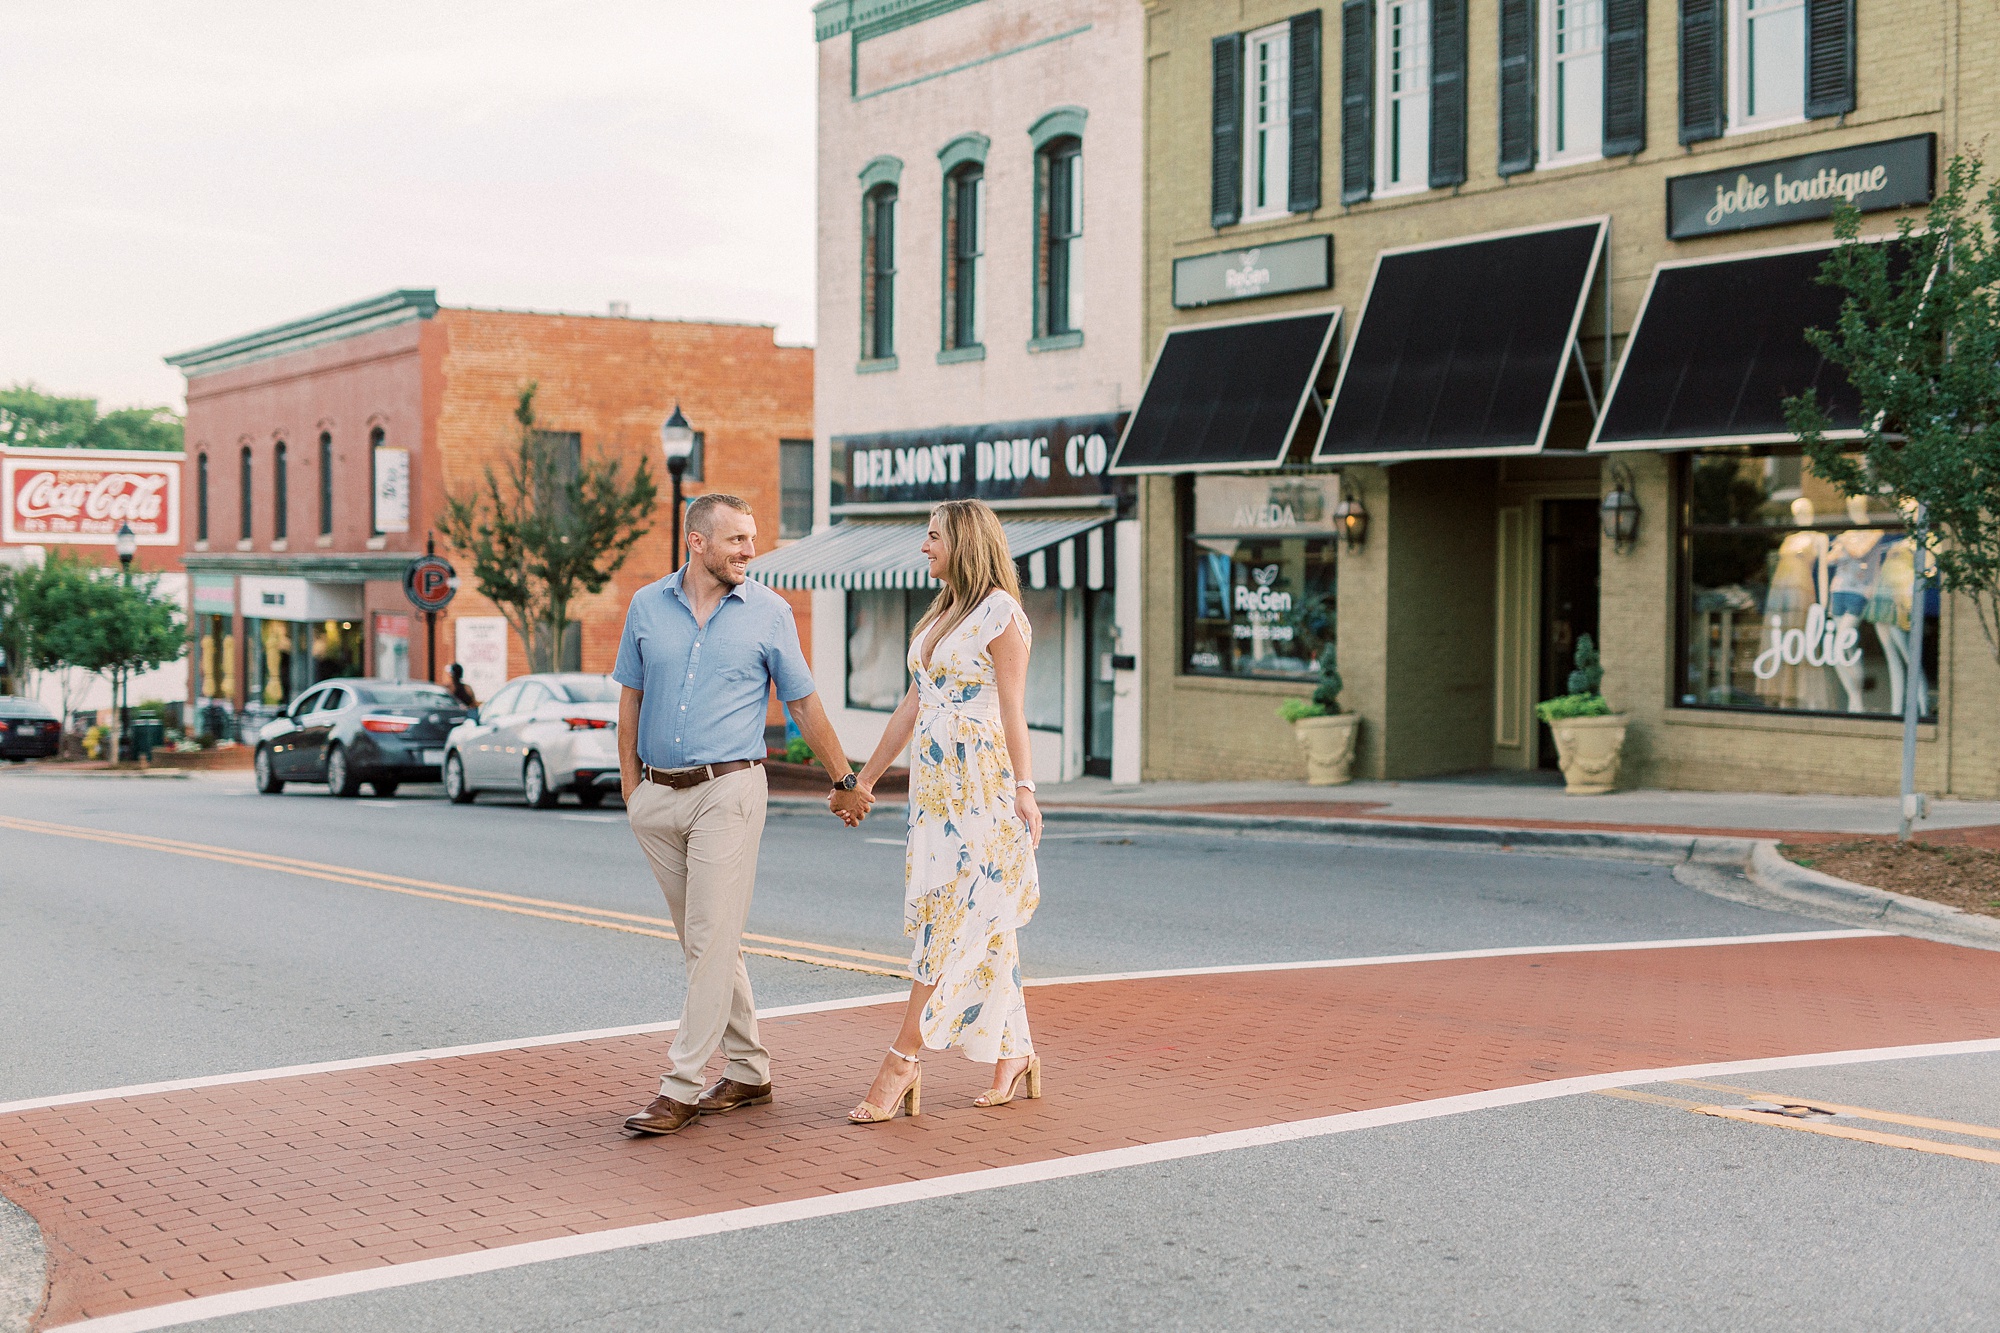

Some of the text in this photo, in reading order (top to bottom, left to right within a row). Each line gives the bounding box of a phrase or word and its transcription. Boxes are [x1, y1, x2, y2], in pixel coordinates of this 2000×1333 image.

[1706, 165, 1888, 226] jolie boutique
[1225, 266, 1270, 289] ReGen
[853, 433, 1107, 487] BELMONT DRUG CO
[17, 471, 166, 520] Coca-Cola
[1233, 503, 1296, 529] AVEDA
[424, 571, 444, 595] P
[1234, 585, 1292, 612] ReGen
[1753, 602, 1862, 680] jolie
